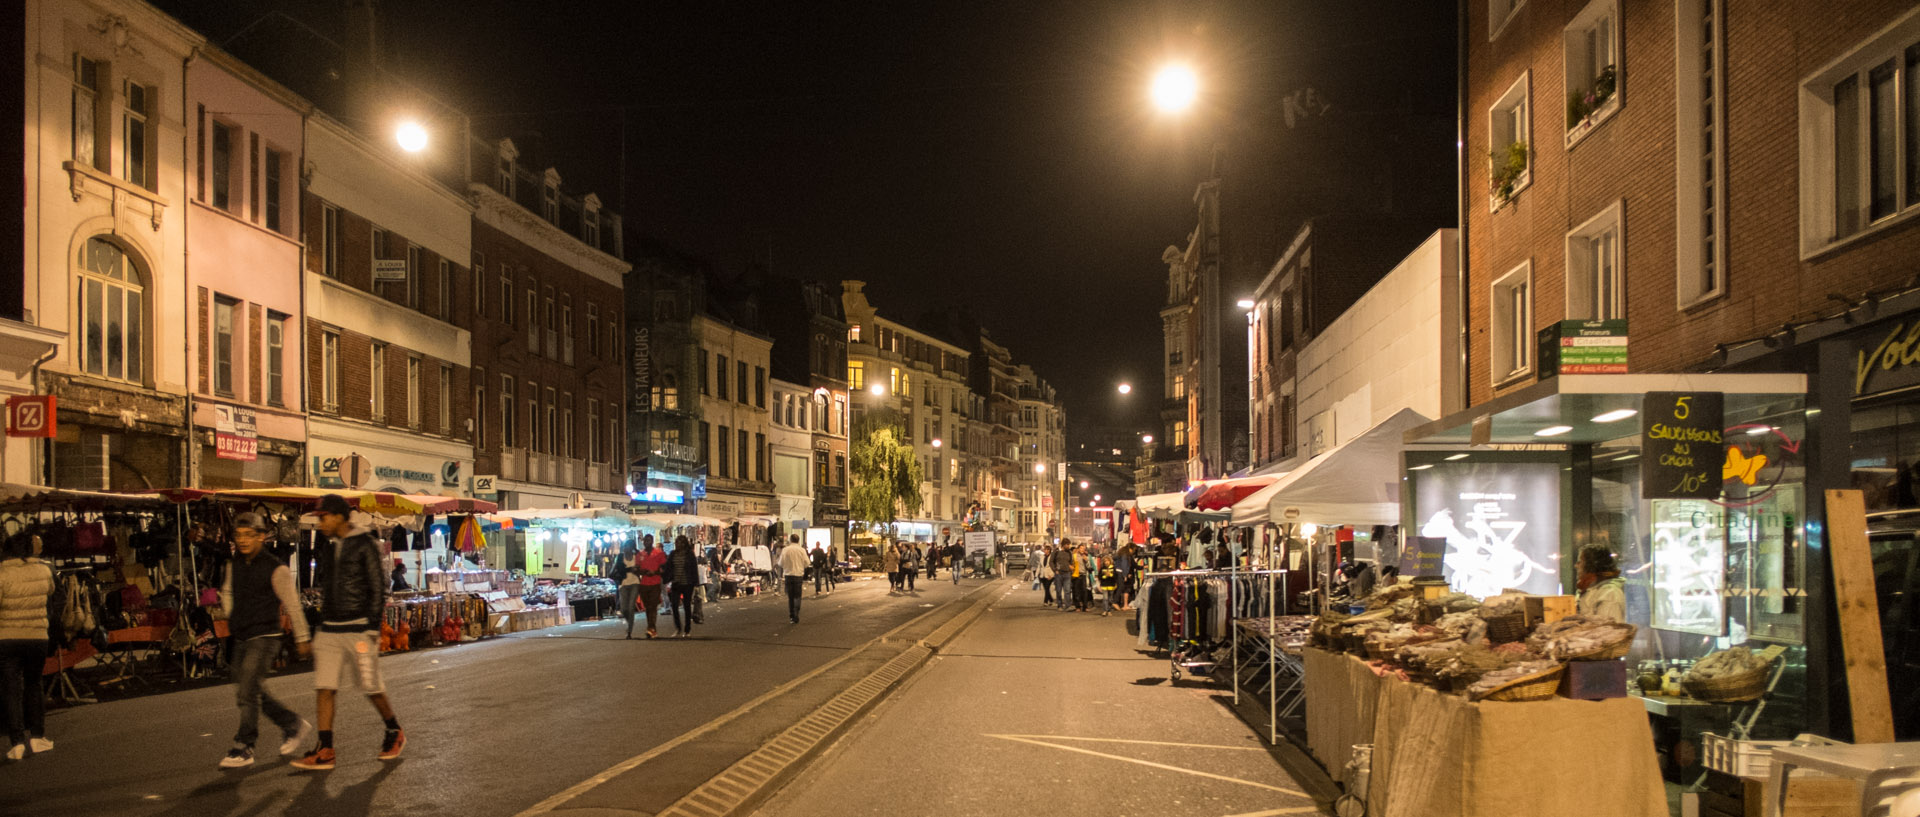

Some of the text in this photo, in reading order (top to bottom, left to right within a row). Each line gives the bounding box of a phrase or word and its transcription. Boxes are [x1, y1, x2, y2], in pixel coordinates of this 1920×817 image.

[1577, 337, 1612, 345] Citadine
[1856, 320, 1920, 395] Vol
[635, 326, 649, 413] LES TANNEURS
[1674, 396, 1692, 420] 5
[218, 437, 226, 450] 03
[241, 440, 249, 453] 22
[250, 441, 257, 454] 22
[660, 441, 697, 463] LES TANNEURS
[1673, 443, 1690, 455] AU
[1660, 454, 1694, 467] CHOIX
[1691, 508, 1795, 529] Citadine
[569, 544, 581, 572] 2
[1405, 546, 1415, 561] 5
